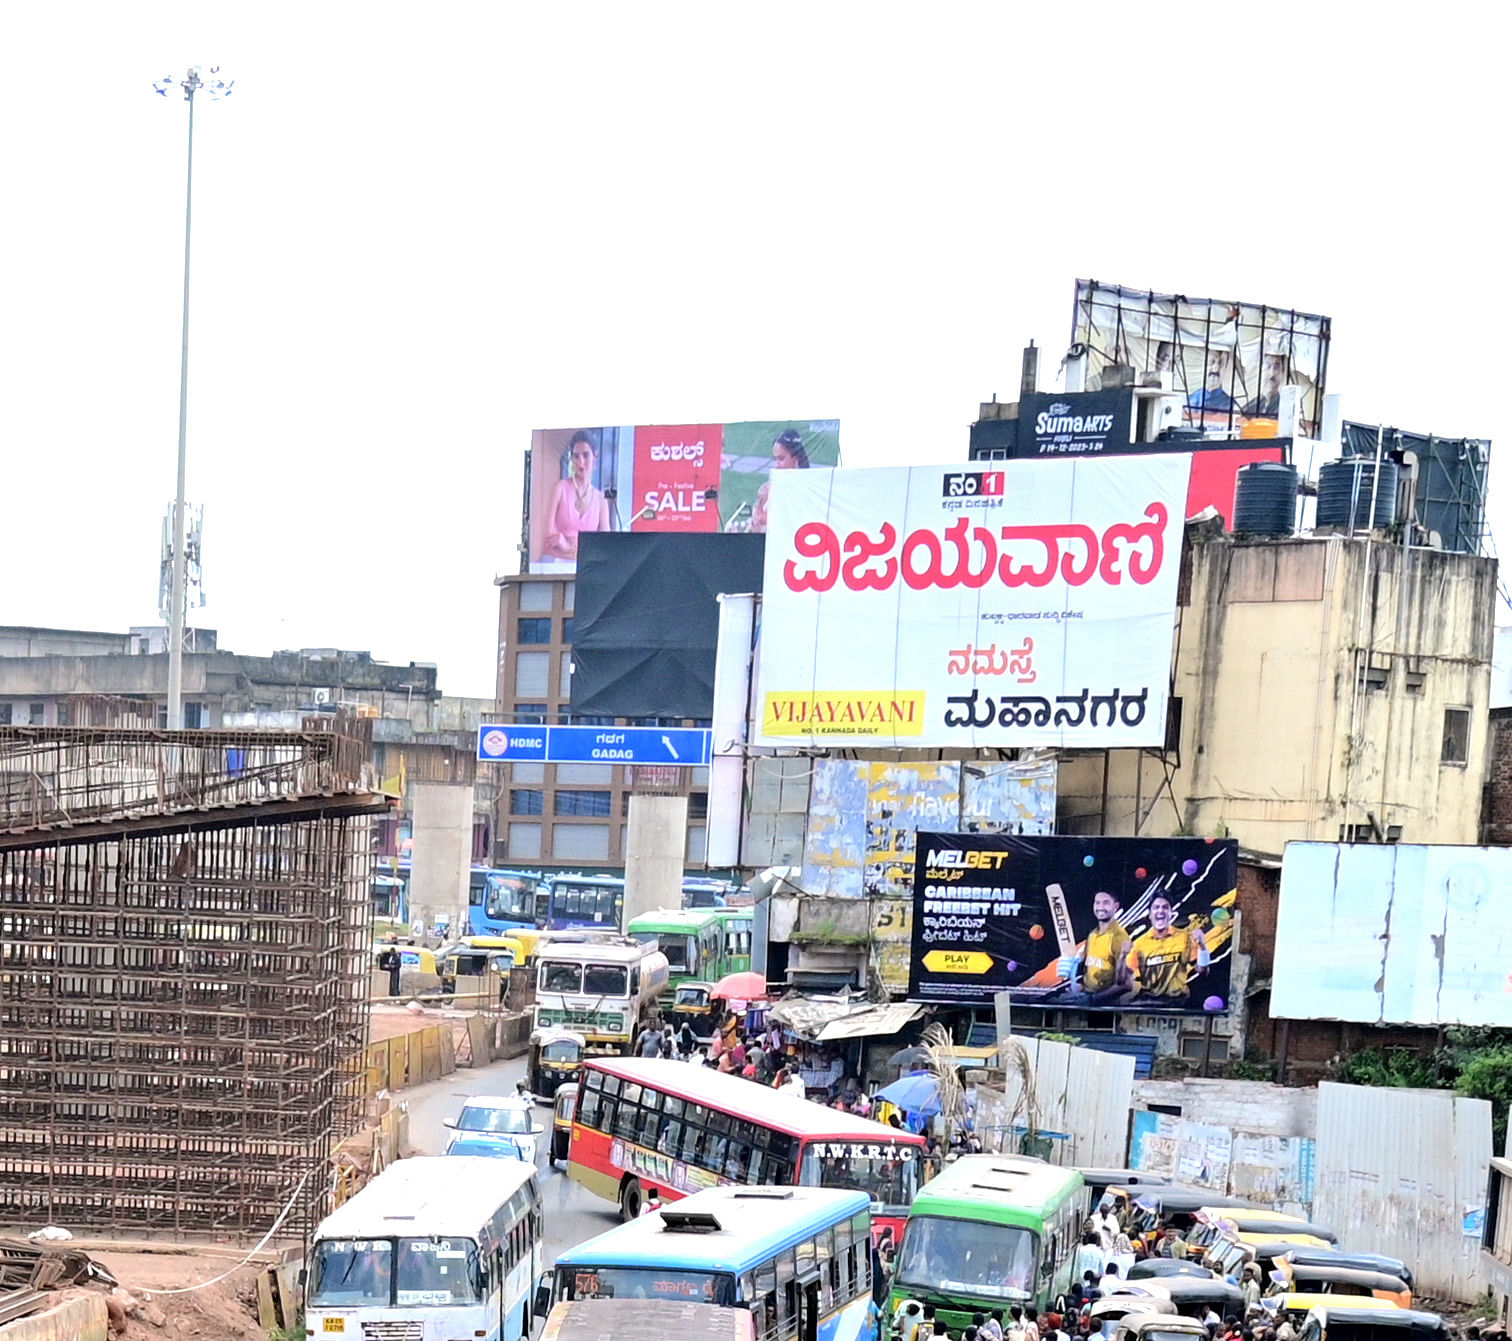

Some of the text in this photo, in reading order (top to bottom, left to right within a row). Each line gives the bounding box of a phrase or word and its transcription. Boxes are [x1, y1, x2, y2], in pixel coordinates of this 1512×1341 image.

[985, 474, 996, 494] 1
[645, 491, 706, 511] SALE
[783, 502, 1168, 592] ವಿಜಯವಾಣಿ
[772, 700, 916, 724] VIJAYAVANI
[944, 688, 1148, 728] ಮಹಾನಗರ
[510, 737, 542, 748] HDMC
[596, 734, 625, 744] ಗದಗ
[592, 748, 633, 759] GADAG
[926, 849, 1008, 869] MELBET
[925, 886, 1015, 900] CARIBBEAN
[924, 901, 1021, 916] FREEBET HIT
[1051, 896, 1072, 943] MELBET
[944, 955, 970, 963] PLAY
